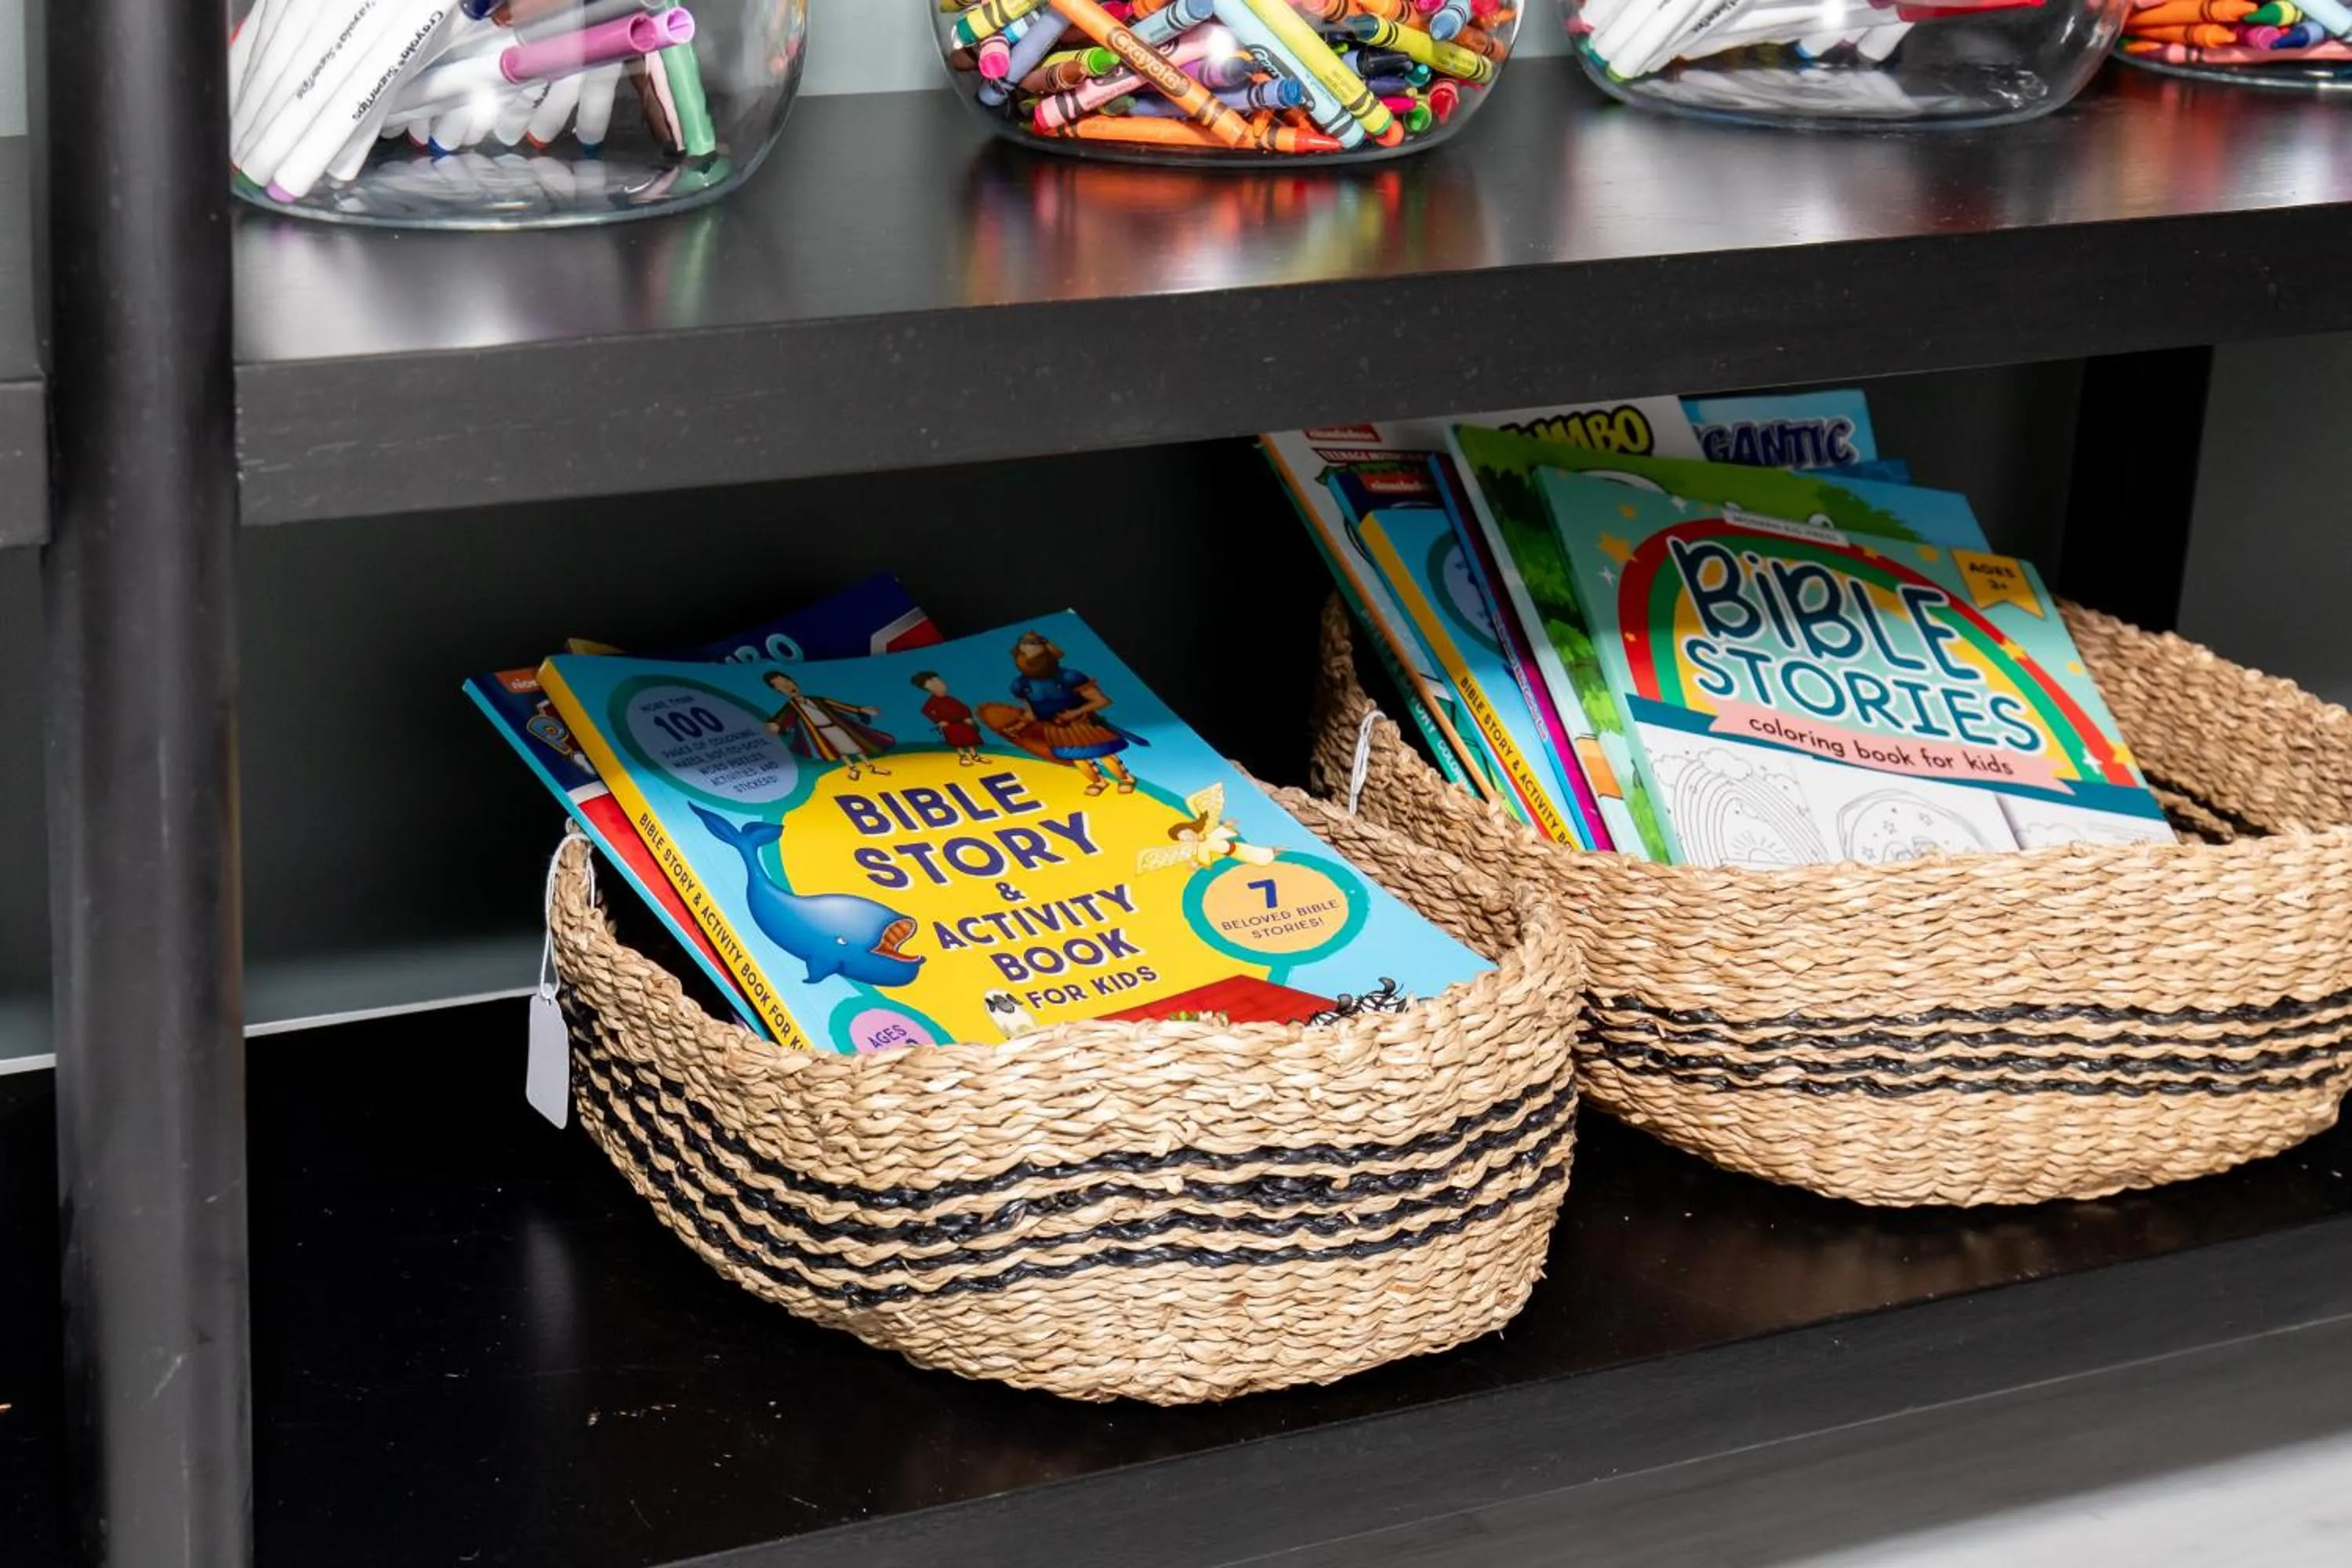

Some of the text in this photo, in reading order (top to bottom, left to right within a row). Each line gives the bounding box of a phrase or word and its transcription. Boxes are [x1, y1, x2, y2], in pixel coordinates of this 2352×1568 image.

[1693, 419, 1857, 468] GANTIC
[1684, 639, 2042, 751] STORIES
[654, 707, 724, 742] 100
[1748, 717, 2014, 775] coloring book for kids
[1437, 739, 1475, 797] COLOR
[1460, 677, 1486, 712] BIBLE
[1484, 715, 1513, 757] STORY
[1512, 760, 1520, 771] &
[1520, 774, 1559, 829] ACTIVITY
[834, 771, 1041, 836] BIBLE
[855, 812, 1101, 889] STORY
[931, 884, 1135, 949] ACTIVITY
[996, 883, 1025, 901] &
[1221, 899, 1338, 931] BELOVED BIBLE
[1247, 879, 1278, 909] 7
[639, 812, 665, 850] BIBLE
[663, 848, 695, 892] STORY
[693, 892, 702, 906] &
[701, 906, 742, 964] ACTIVITY
[741, 964, 771, 1007] BOOK
[769, 1004, 791, 1038] FOR
[1251, 917, 1325, 939] STORIES!
[991, 930, 1142, 982] BOOK
[1029, 967, 1158, 1009] FOR KIDS
[867, 1025, 907, 1048] AGES
